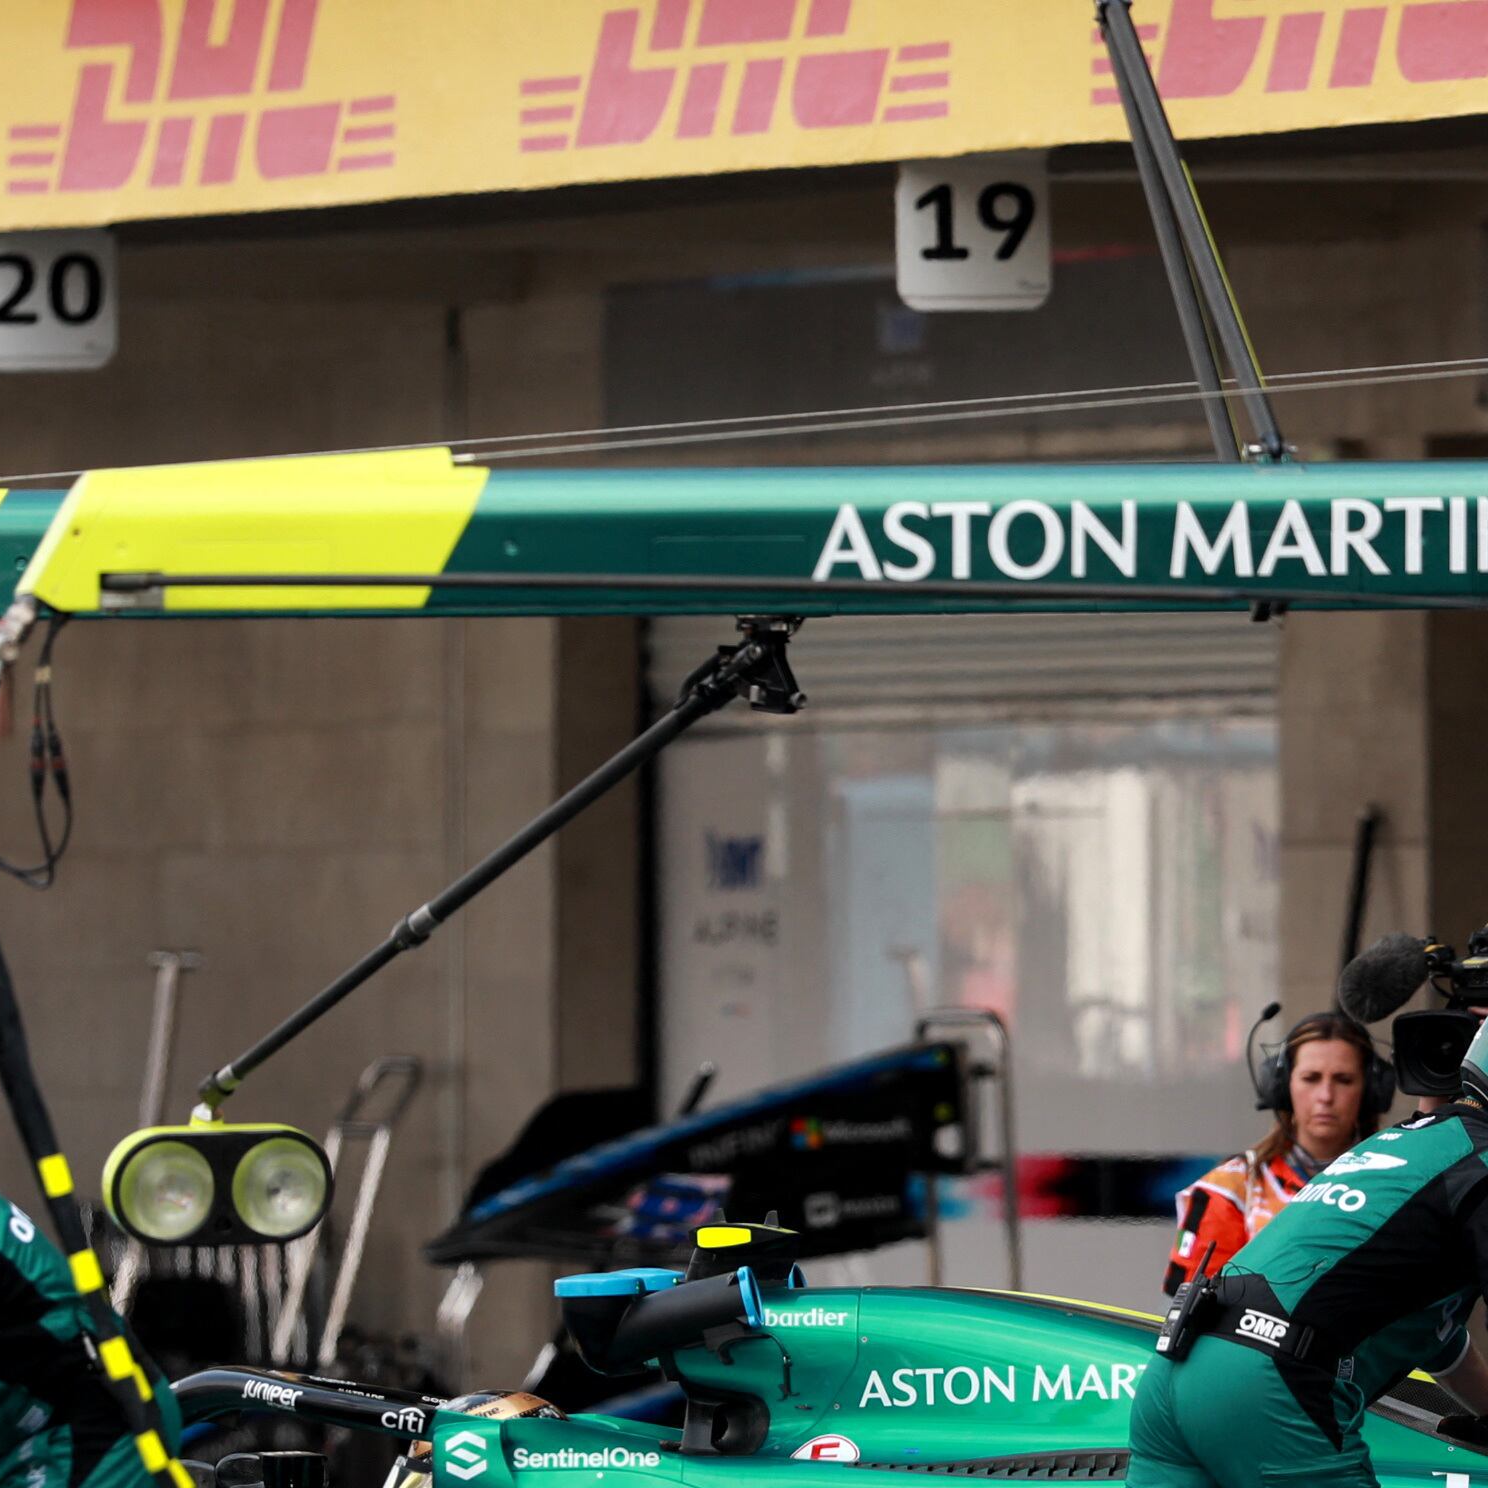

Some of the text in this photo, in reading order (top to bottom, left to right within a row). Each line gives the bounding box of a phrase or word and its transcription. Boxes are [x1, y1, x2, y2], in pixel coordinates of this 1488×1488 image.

[915, 183, 1035, 262] 19
[812, 500, 1137, 581] ASTON
[1239, 1314, 1287, 1340] OMP
[859, 1364, 1147, 1408] ASTON MAR
[381, 1407, 426, 1434] citi
[513, 1446, 660, 1470] SentinelOne
